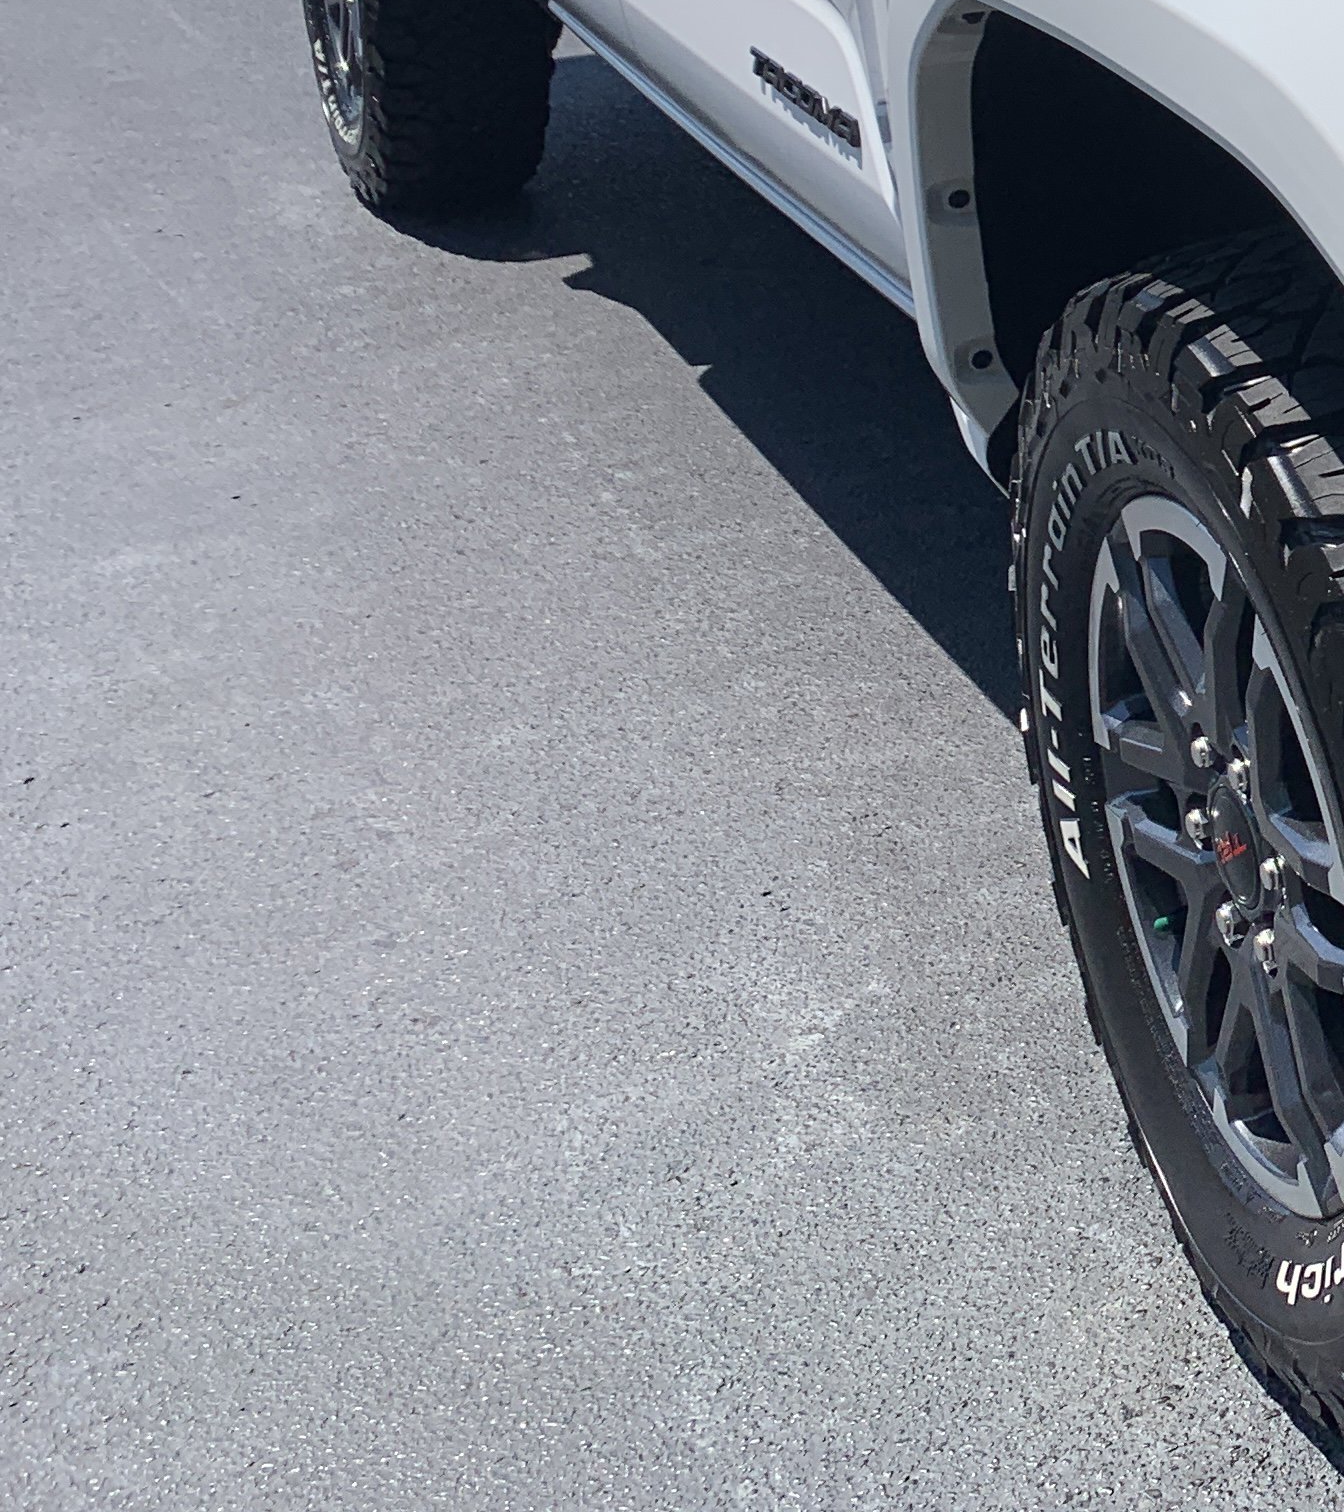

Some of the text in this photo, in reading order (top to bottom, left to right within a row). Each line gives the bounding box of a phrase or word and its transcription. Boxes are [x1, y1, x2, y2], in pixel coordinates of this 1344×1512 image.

[749, 45, 862, 148] TACOMA
[1039, 462, 1091, 881] All-Terrain
[1074, 431, 1134, 476] T/A
